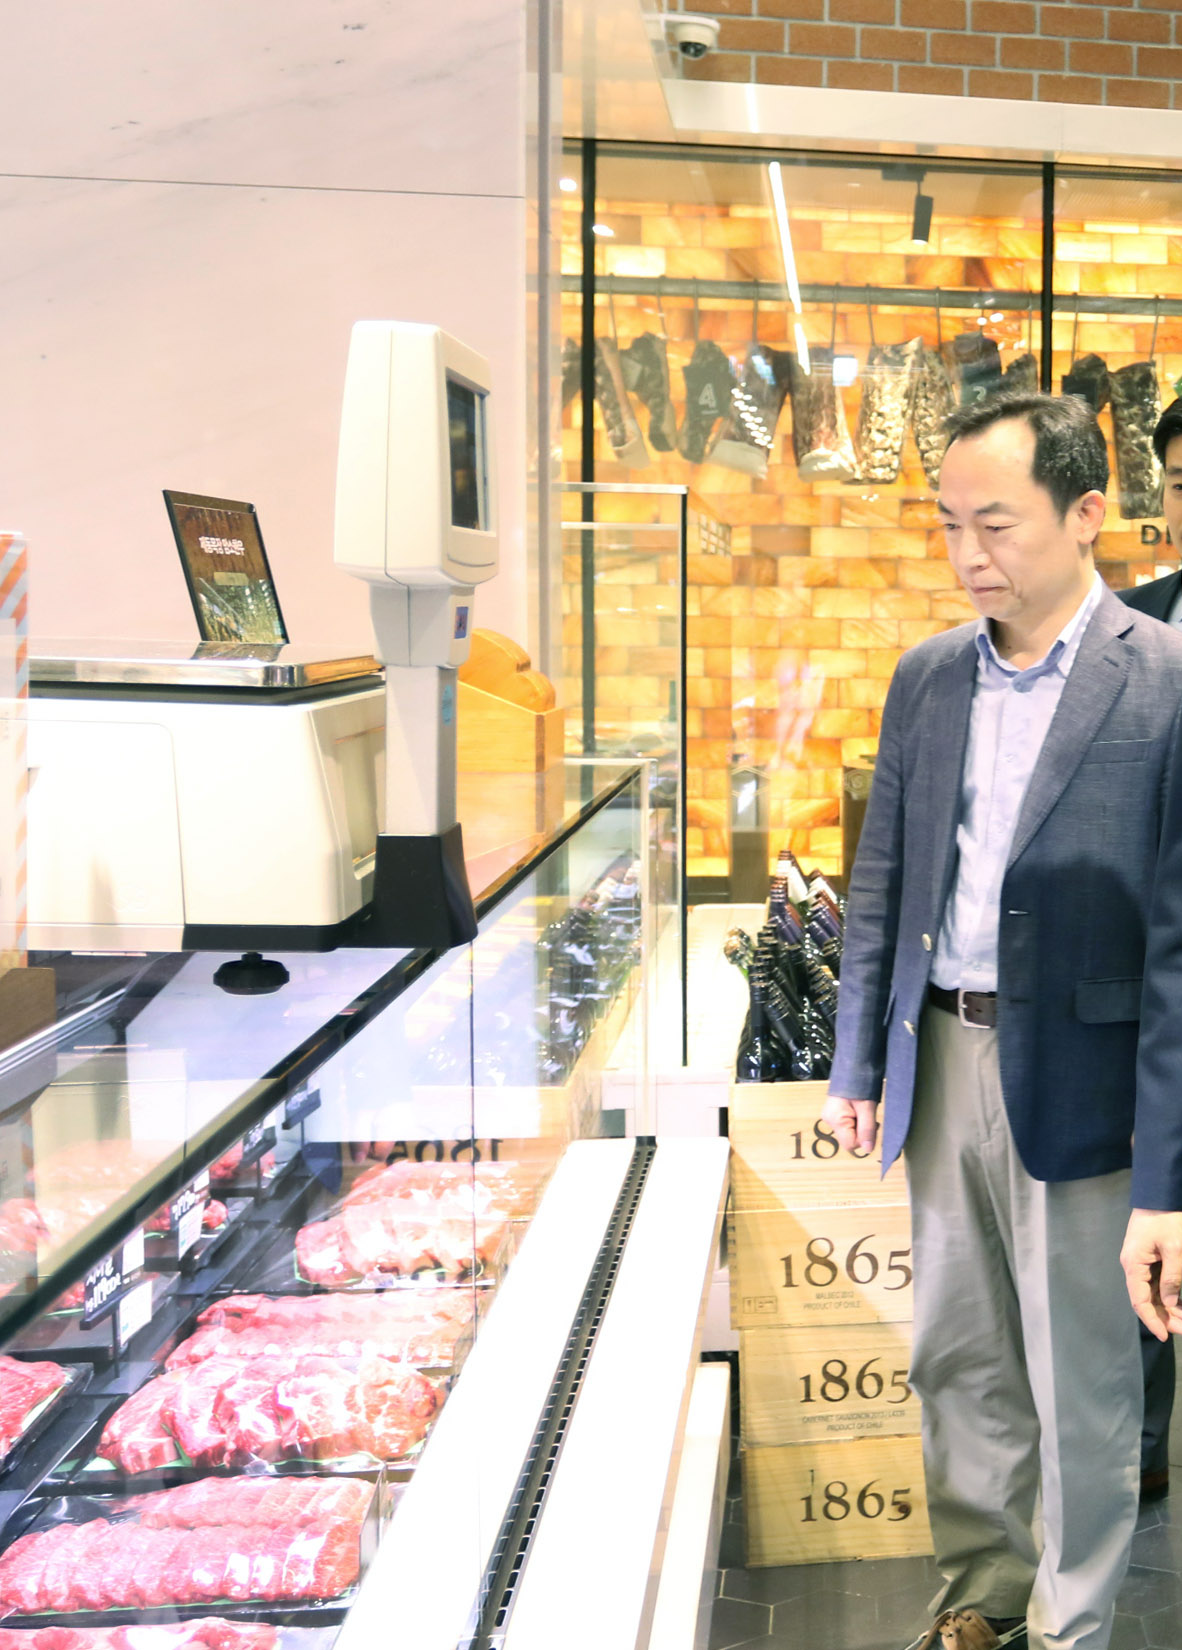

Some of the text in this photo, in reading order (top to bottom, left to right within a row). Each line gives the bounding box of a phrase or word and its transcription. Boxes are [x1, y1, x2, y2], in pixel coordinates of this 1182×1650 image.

[698, 383, 717, 409] 4
[780, 1234, 913, 1290] 1865
[799, 1357, 913, 1404] 1865
[800, 1478, 912, 1523] 1865
